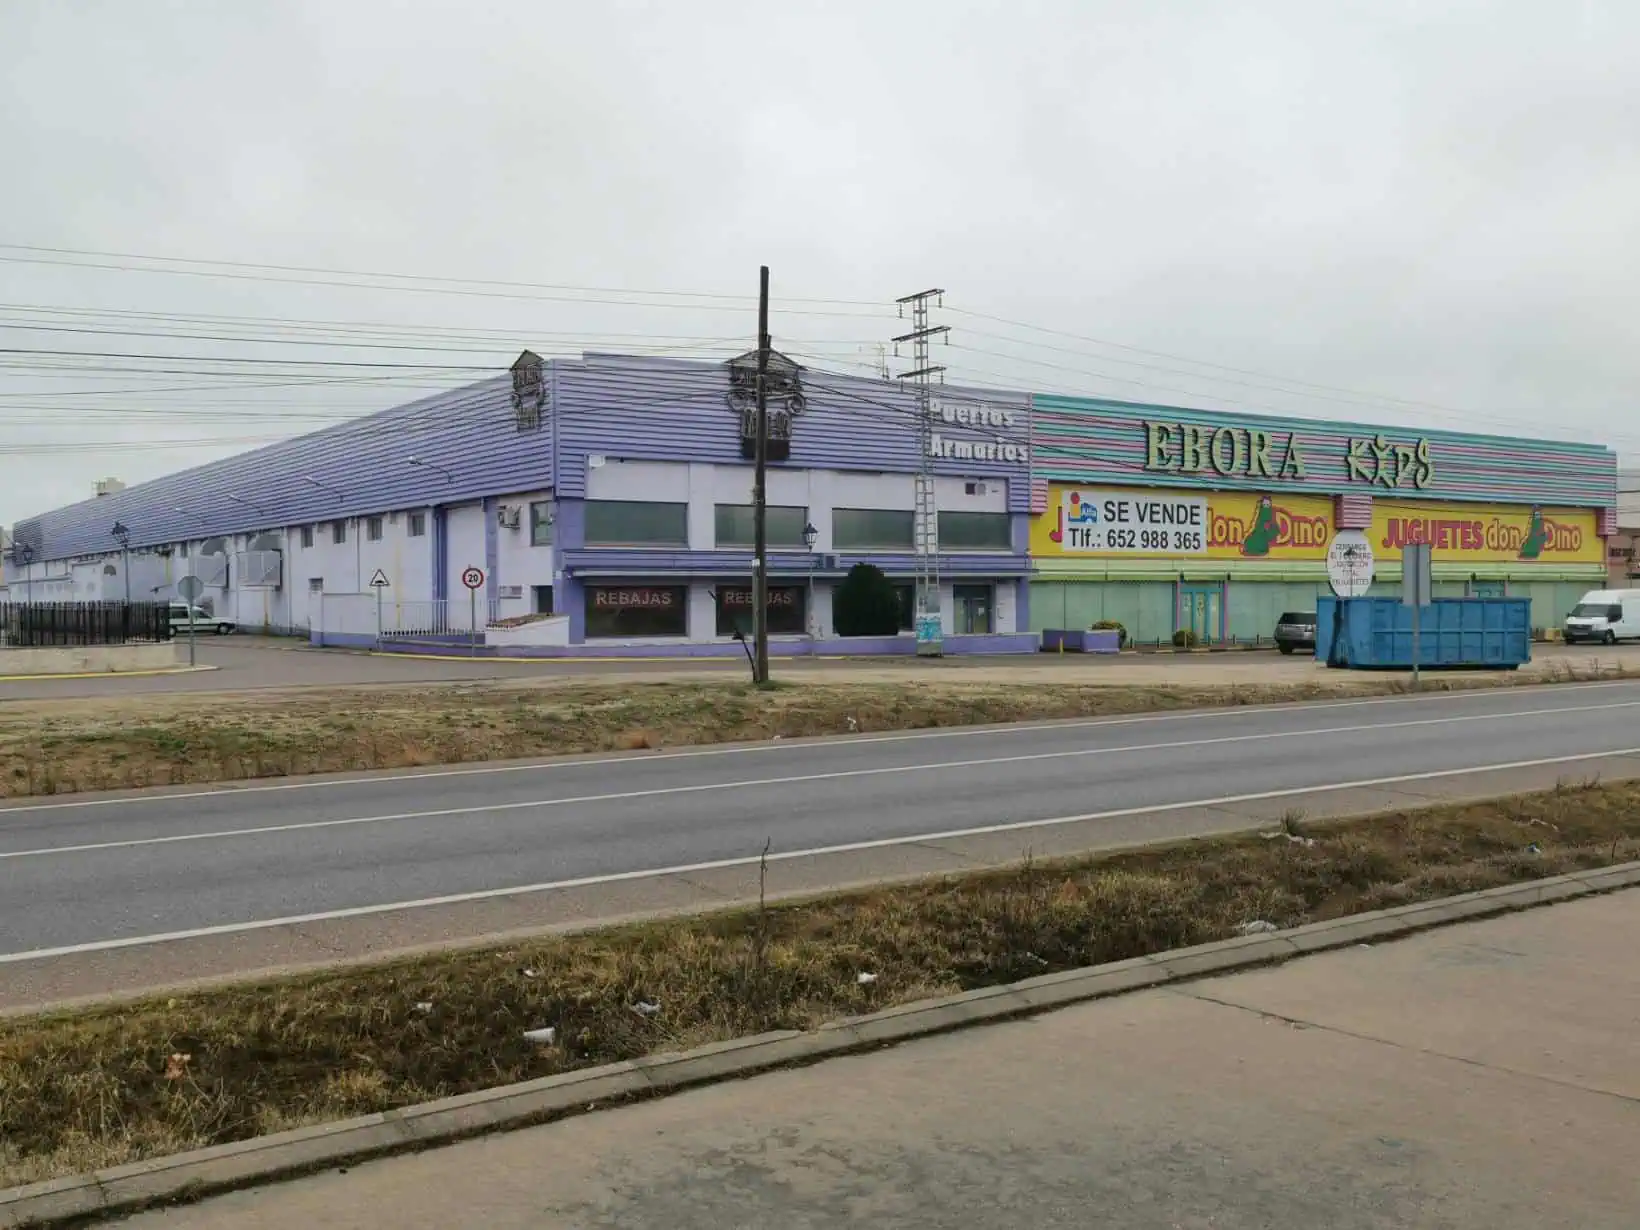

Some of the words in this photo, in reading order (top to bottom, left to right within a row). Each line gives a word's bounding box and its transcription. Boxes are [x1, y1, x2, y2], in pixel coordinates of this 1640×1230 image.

[929, 434, 1029, 461] Armarios
[1143, 420, 1306, 478] EBORA
[1103, 500, 1129, 522] SE
[1135, 502, 1201, 525] VENDE
[1107, 529, 1136, 548] 652
[1141, 531, 1169, 550] 988
[1173, 531, 1201, 550] 365
[1273, 508, 1328, 546] Dino
[1382, 518, 1484, 549] JUGUETES
[1486, 518, 1521, 550] don
[1543, 517, 1582, 551] Dino
[467, 573, 479, 583] 20
[596, 591, 673, 605] REBAJAS
[725, 591, 793, 606] REBJAS
